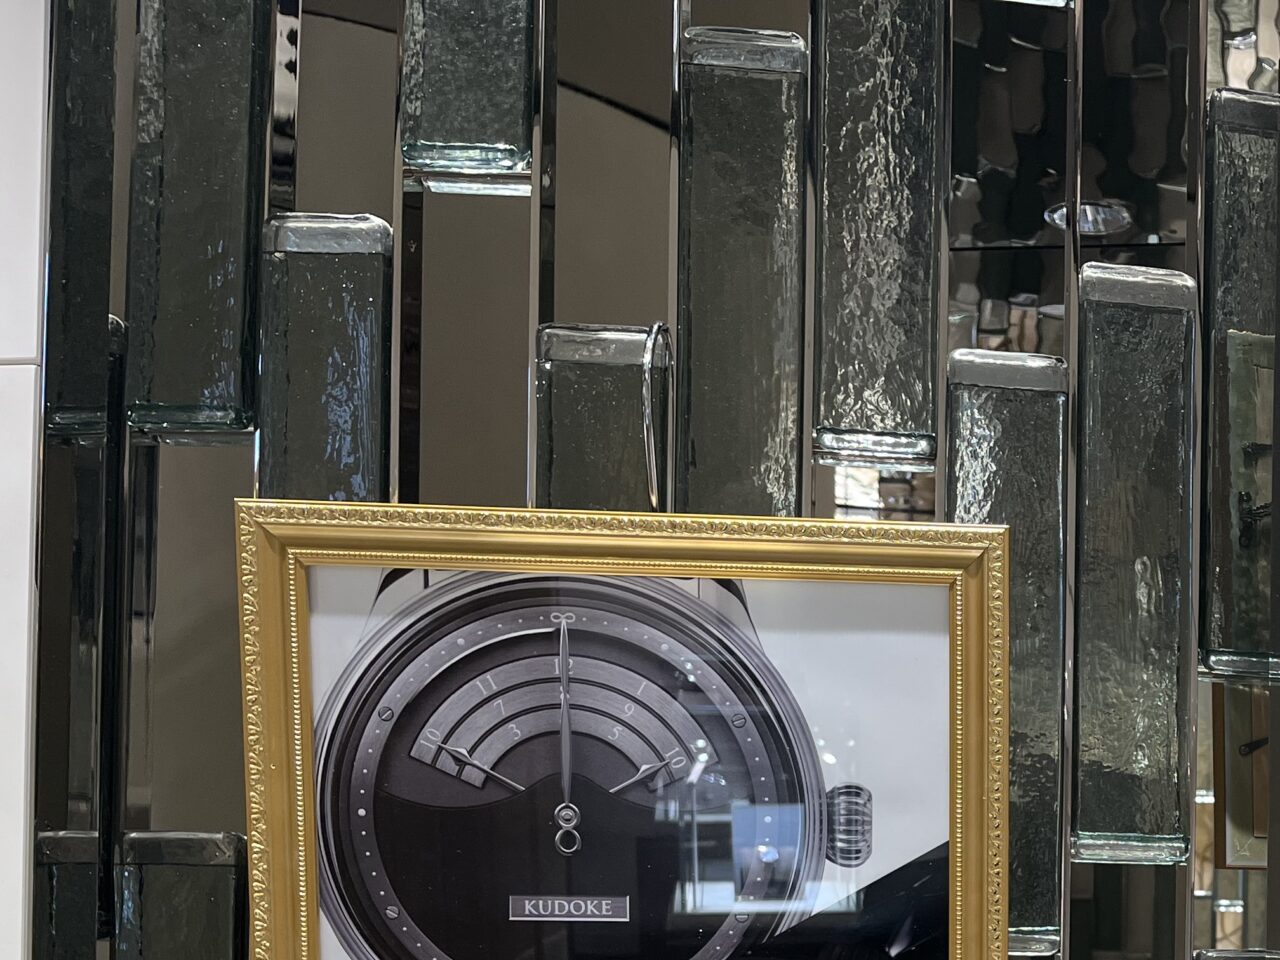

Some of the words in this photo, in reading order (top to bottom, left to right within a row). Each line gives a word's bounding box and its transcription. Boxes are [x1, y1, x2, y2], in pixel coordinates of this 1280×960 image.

[476, 674, 498, 695] 11
[493, 699, 505, 715] 7
[621, 703, 635, 719] 9
[508, 723, 521, 740] 3
[607, 726, 623, 741] 5
[524, 899, 613, 915] KUDOKE
